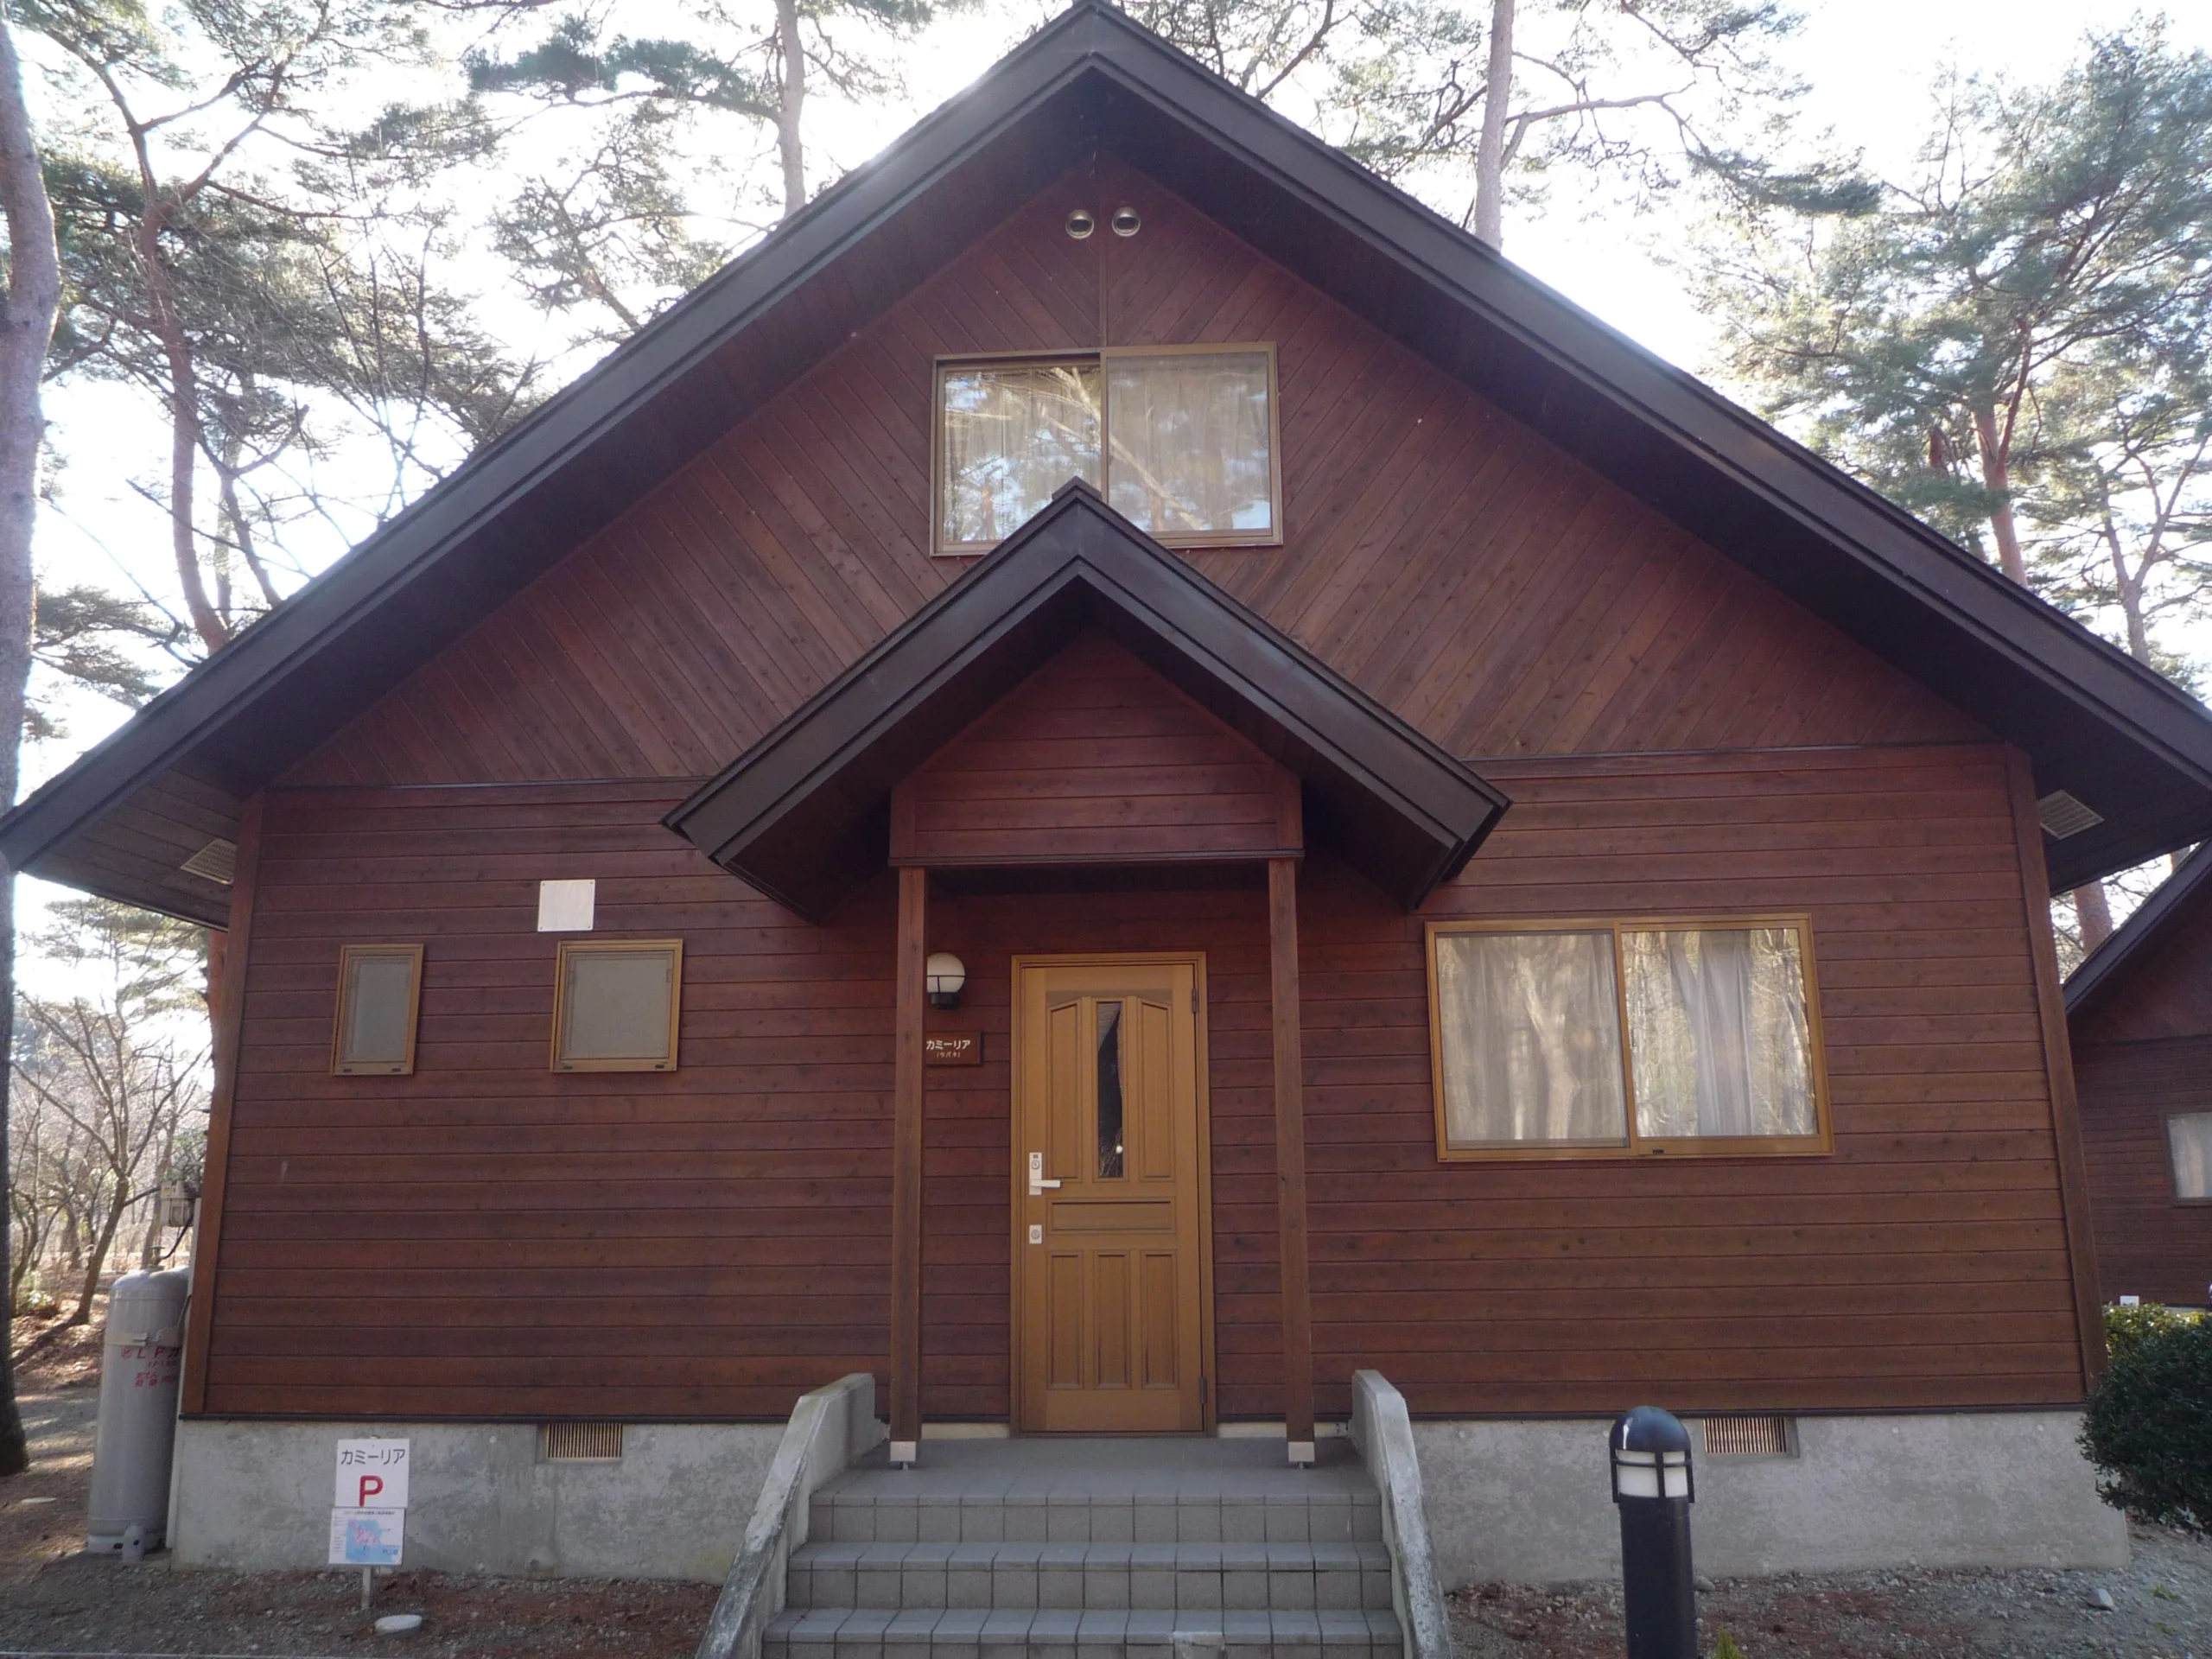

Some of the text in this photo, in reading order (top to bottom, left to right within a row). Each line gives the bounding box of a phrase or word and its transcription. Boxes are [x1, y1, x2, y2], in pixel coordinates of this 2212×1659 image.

[926, 1039, 970, 1050] カミーリア
[340, 1449, 405, 1465] カミーリア
[359, 1475, 383, 1507] P
